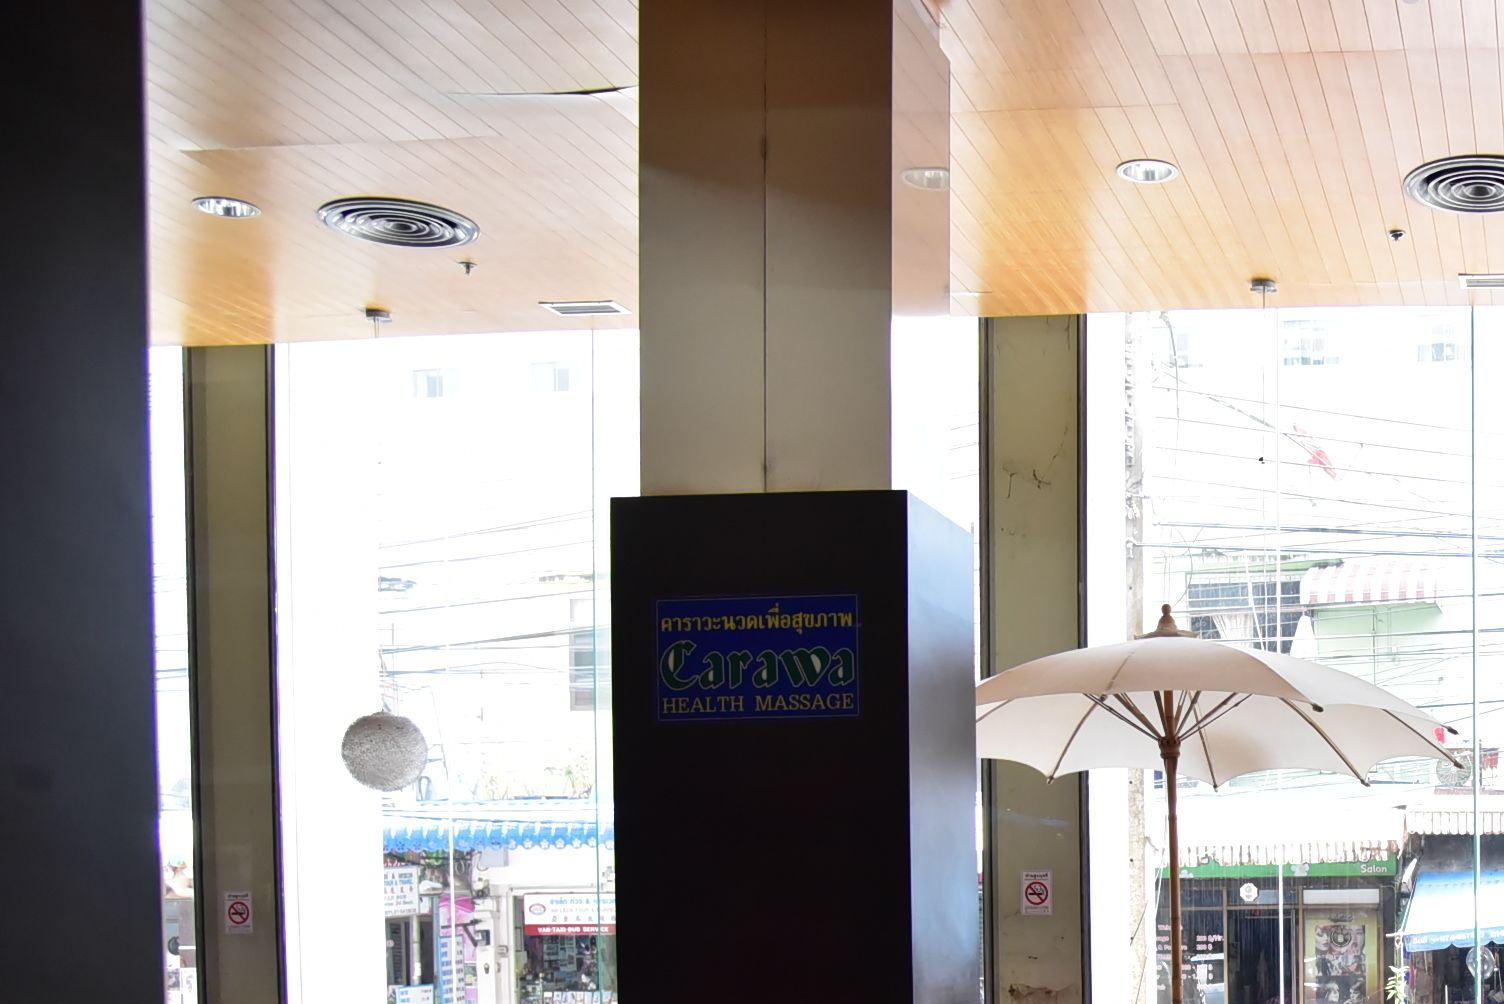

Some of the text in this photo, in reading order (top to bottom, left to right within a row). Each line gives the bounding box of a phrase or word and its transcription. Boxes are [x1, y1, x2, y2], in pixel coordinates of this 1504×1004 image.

[661, 603, 852, 635] คาราวะนวดเพื่อสุขภาพ
[660, 640, 855, 691] Carawa
[662, 693, 854, 714] HEALTH MASSAGE
[1361, 864, 1387, 873] Salon
